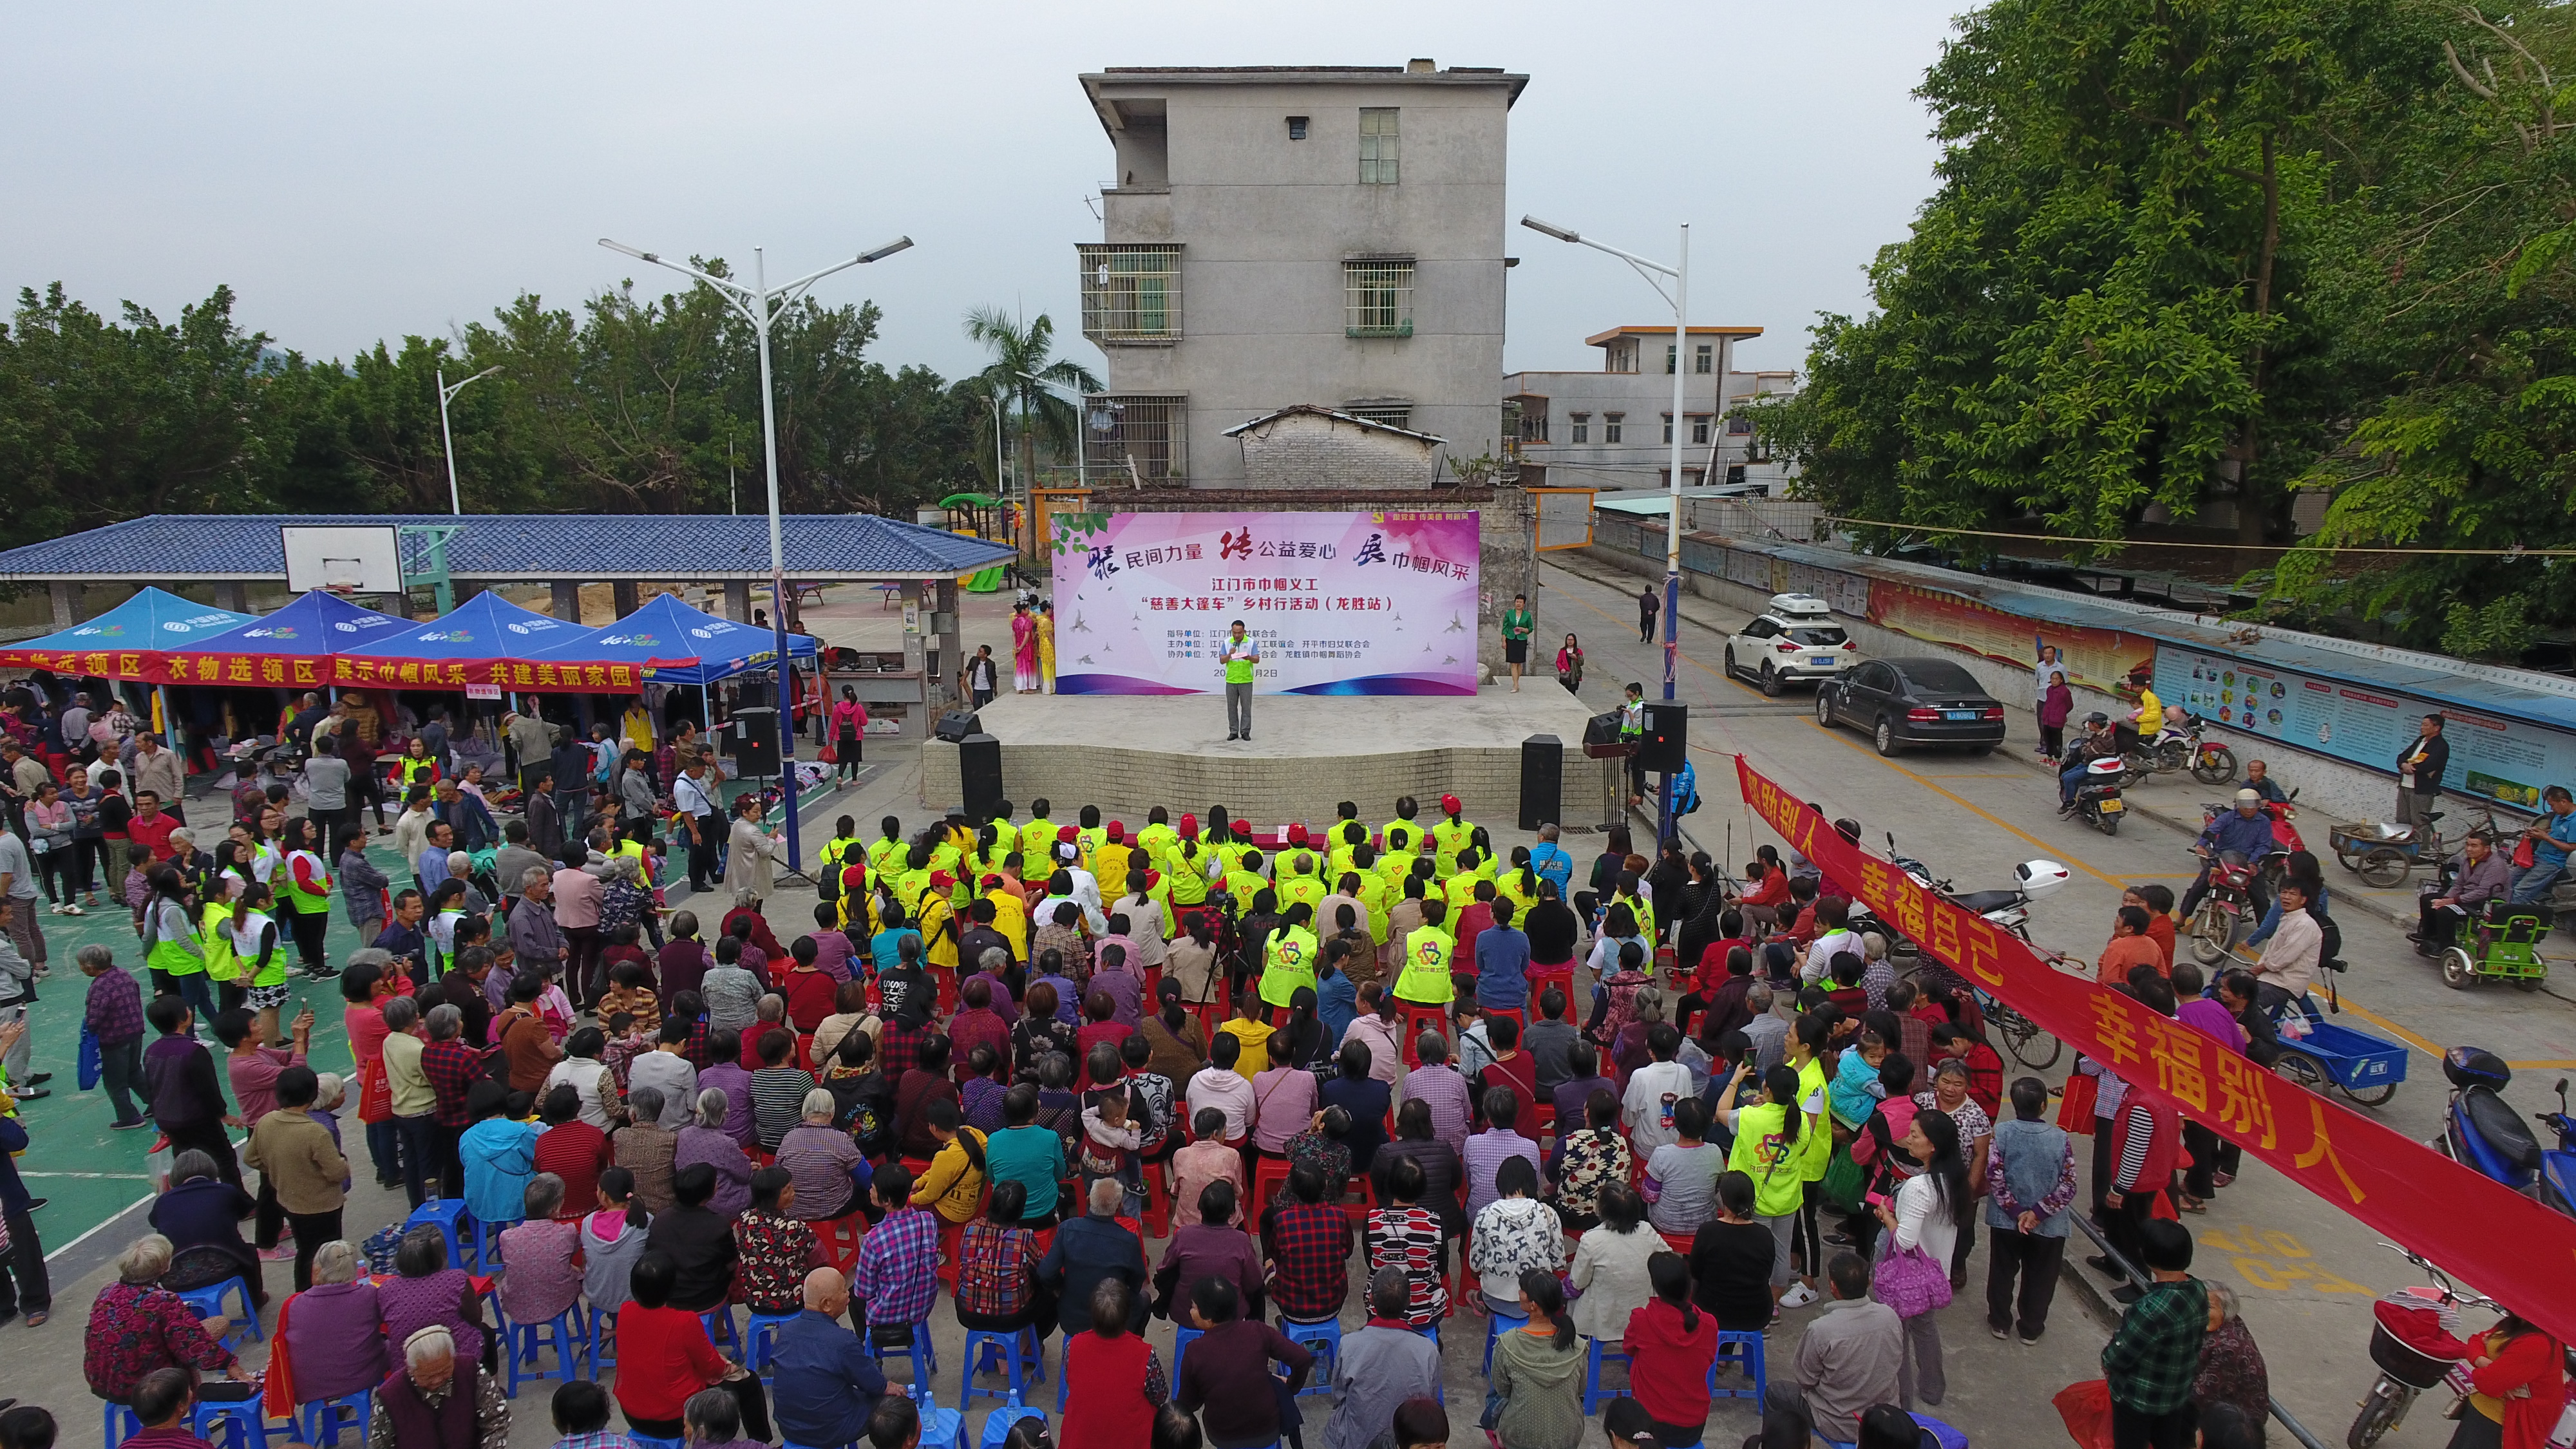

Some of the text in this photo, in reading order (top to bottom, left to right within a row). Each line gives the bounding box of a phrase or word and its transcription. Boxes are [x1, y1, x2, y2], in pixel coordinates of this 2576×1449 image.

[1125, 543, 1204, 570] 民间力量
[1220, 526, 1254, 562] 传
[1258, 540, 1337, 561] 公益爱心
[1352, 533, 1387, 567] 展
[1392, 552, 1471, 582] 巾帼风采
[1211, 577, 1319, 592] 江门市巾帼义工
[184, 613, 232, 625] 中国移动
[1167, 629, 1278, 638] 指导单位：江门市女联合会
[1302, 640, 1370, 649] 开平市妇女联合会
[168, 656, 317, 683] 衣物选领区
[335, 658, 467, 685] 展示巾帼风采
[489, 663, 632, 687] 共建美丽家园
[888, 980, 900, 1012] SJYP
[1861, 862, 2003, 987] 幸福自己
[2088, 992, 2367, 1205] 幸福别人
